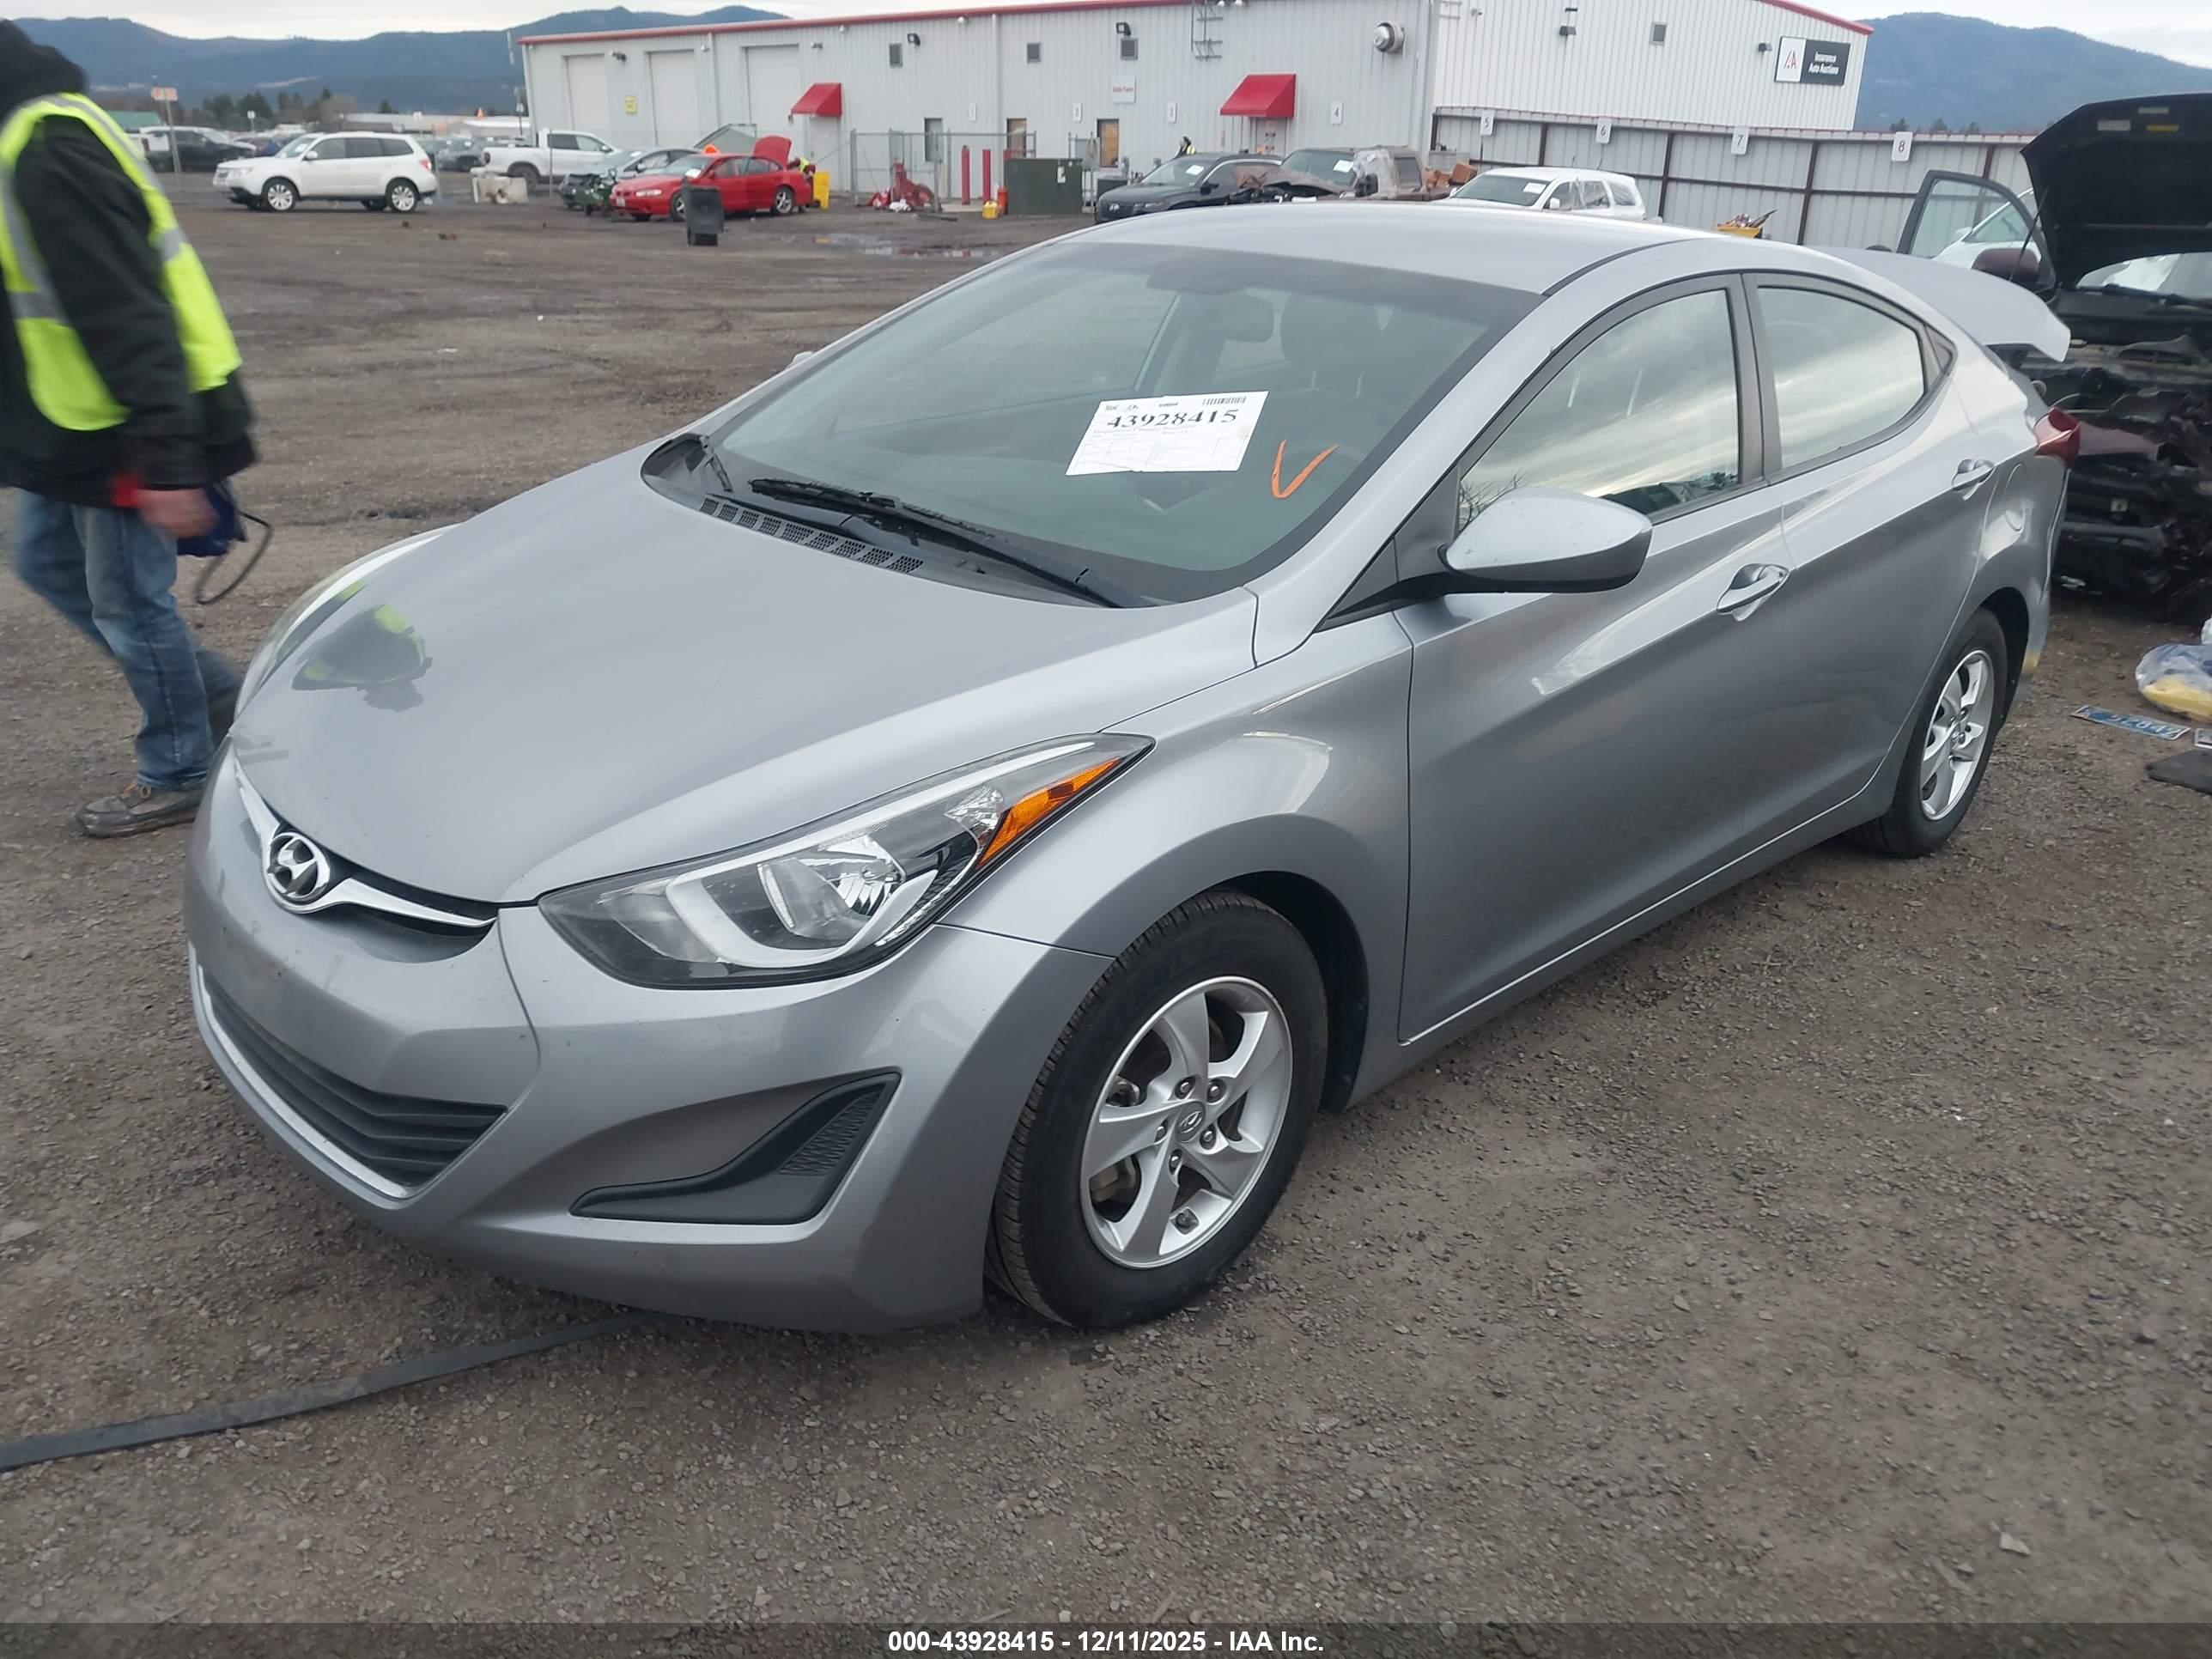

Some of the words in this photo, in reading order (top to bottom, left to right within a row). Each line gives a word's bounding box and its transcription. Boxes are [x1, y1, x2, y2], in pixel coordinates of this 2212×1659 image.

[1814, 51, 1837, 64] Insurance
[1808, 62, 1820, 74] Auto
[1820, 63, 1839, 76] Auctions
[1334, 106, 1340, 118] 4
[1600, 125, 1607, 136] 6
[1736, 134, 1744, 147] 7
[1898, 140, 1906, 153] 8
[1107, 409, 1239, 428] 43928415
